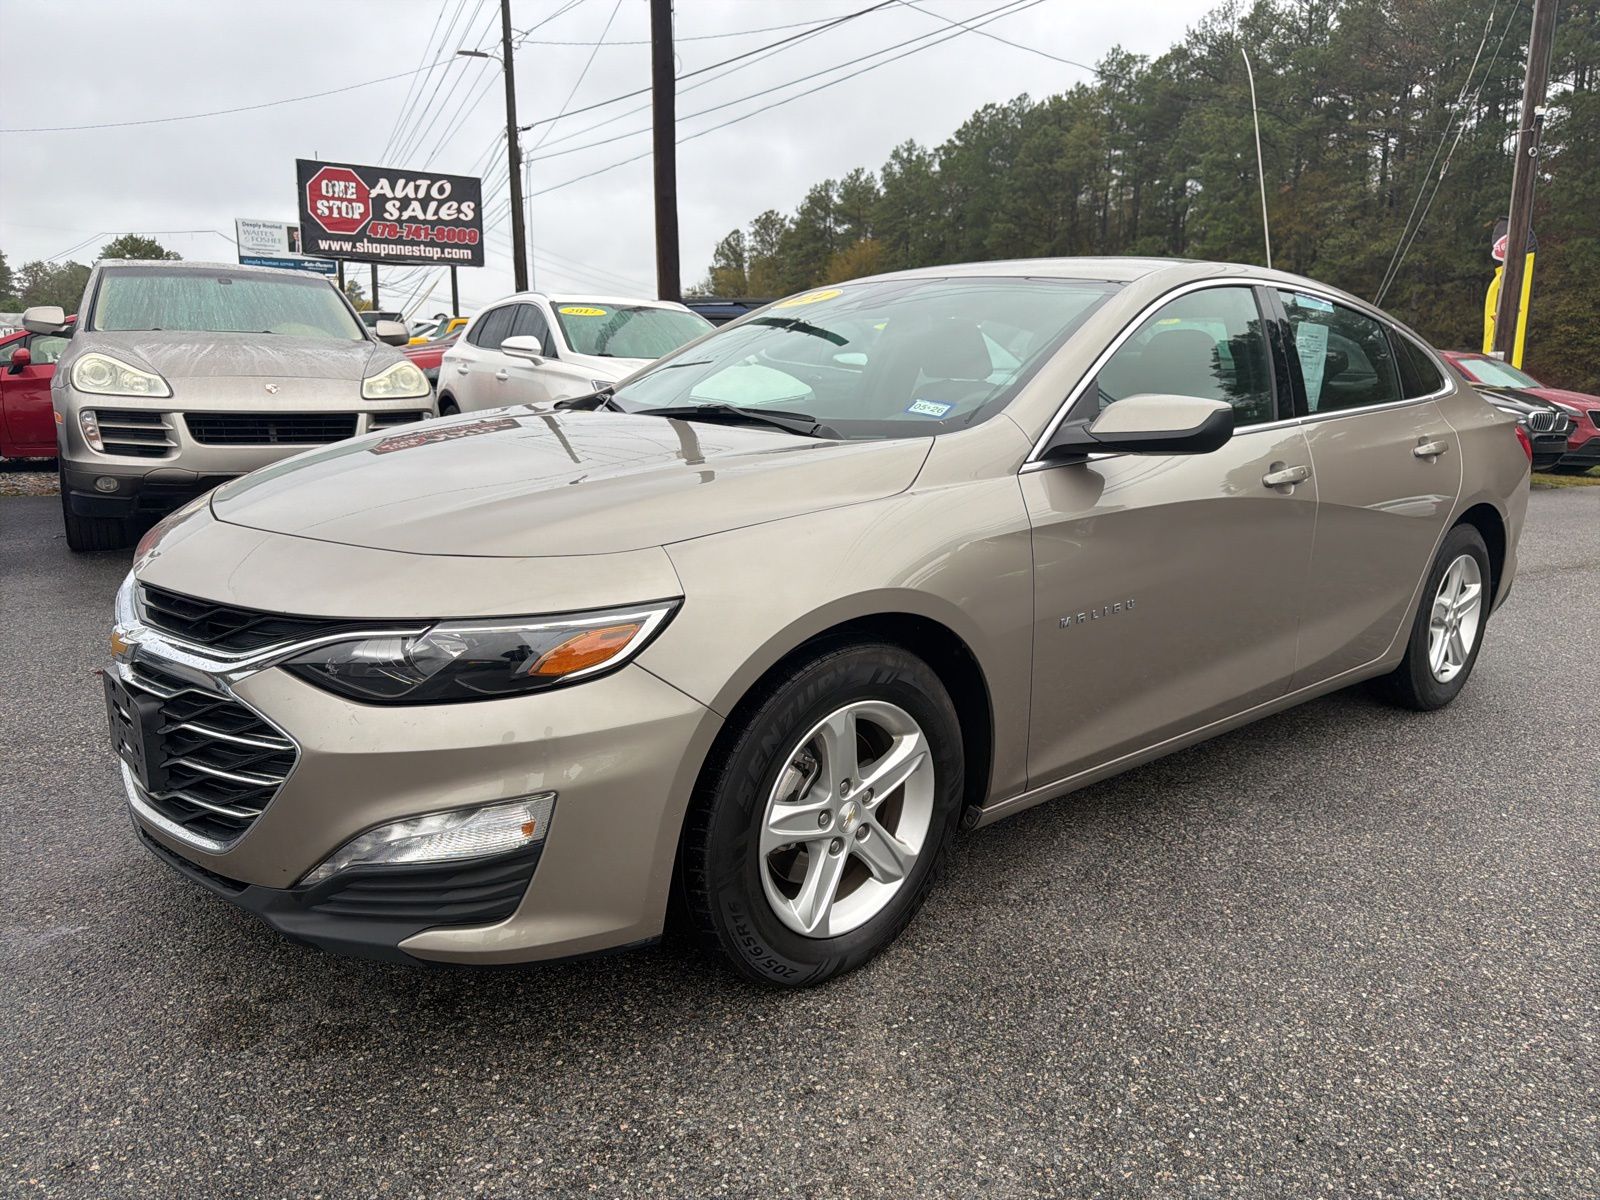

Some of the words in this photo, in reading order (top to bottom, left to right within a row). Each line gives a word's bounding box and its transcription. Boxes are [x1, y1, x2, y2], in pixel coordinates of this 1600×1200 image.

[321, 179, 357, 199] ONE
[369, 177, 452, 199] AUTO
[316, 199, 365, 219] STOP
[367, 220, 480, 245] 478-741-8009
[318, 238, 472, 260] www.shoponestop.com
[1059, 599, 1136, 628] MALIBU
